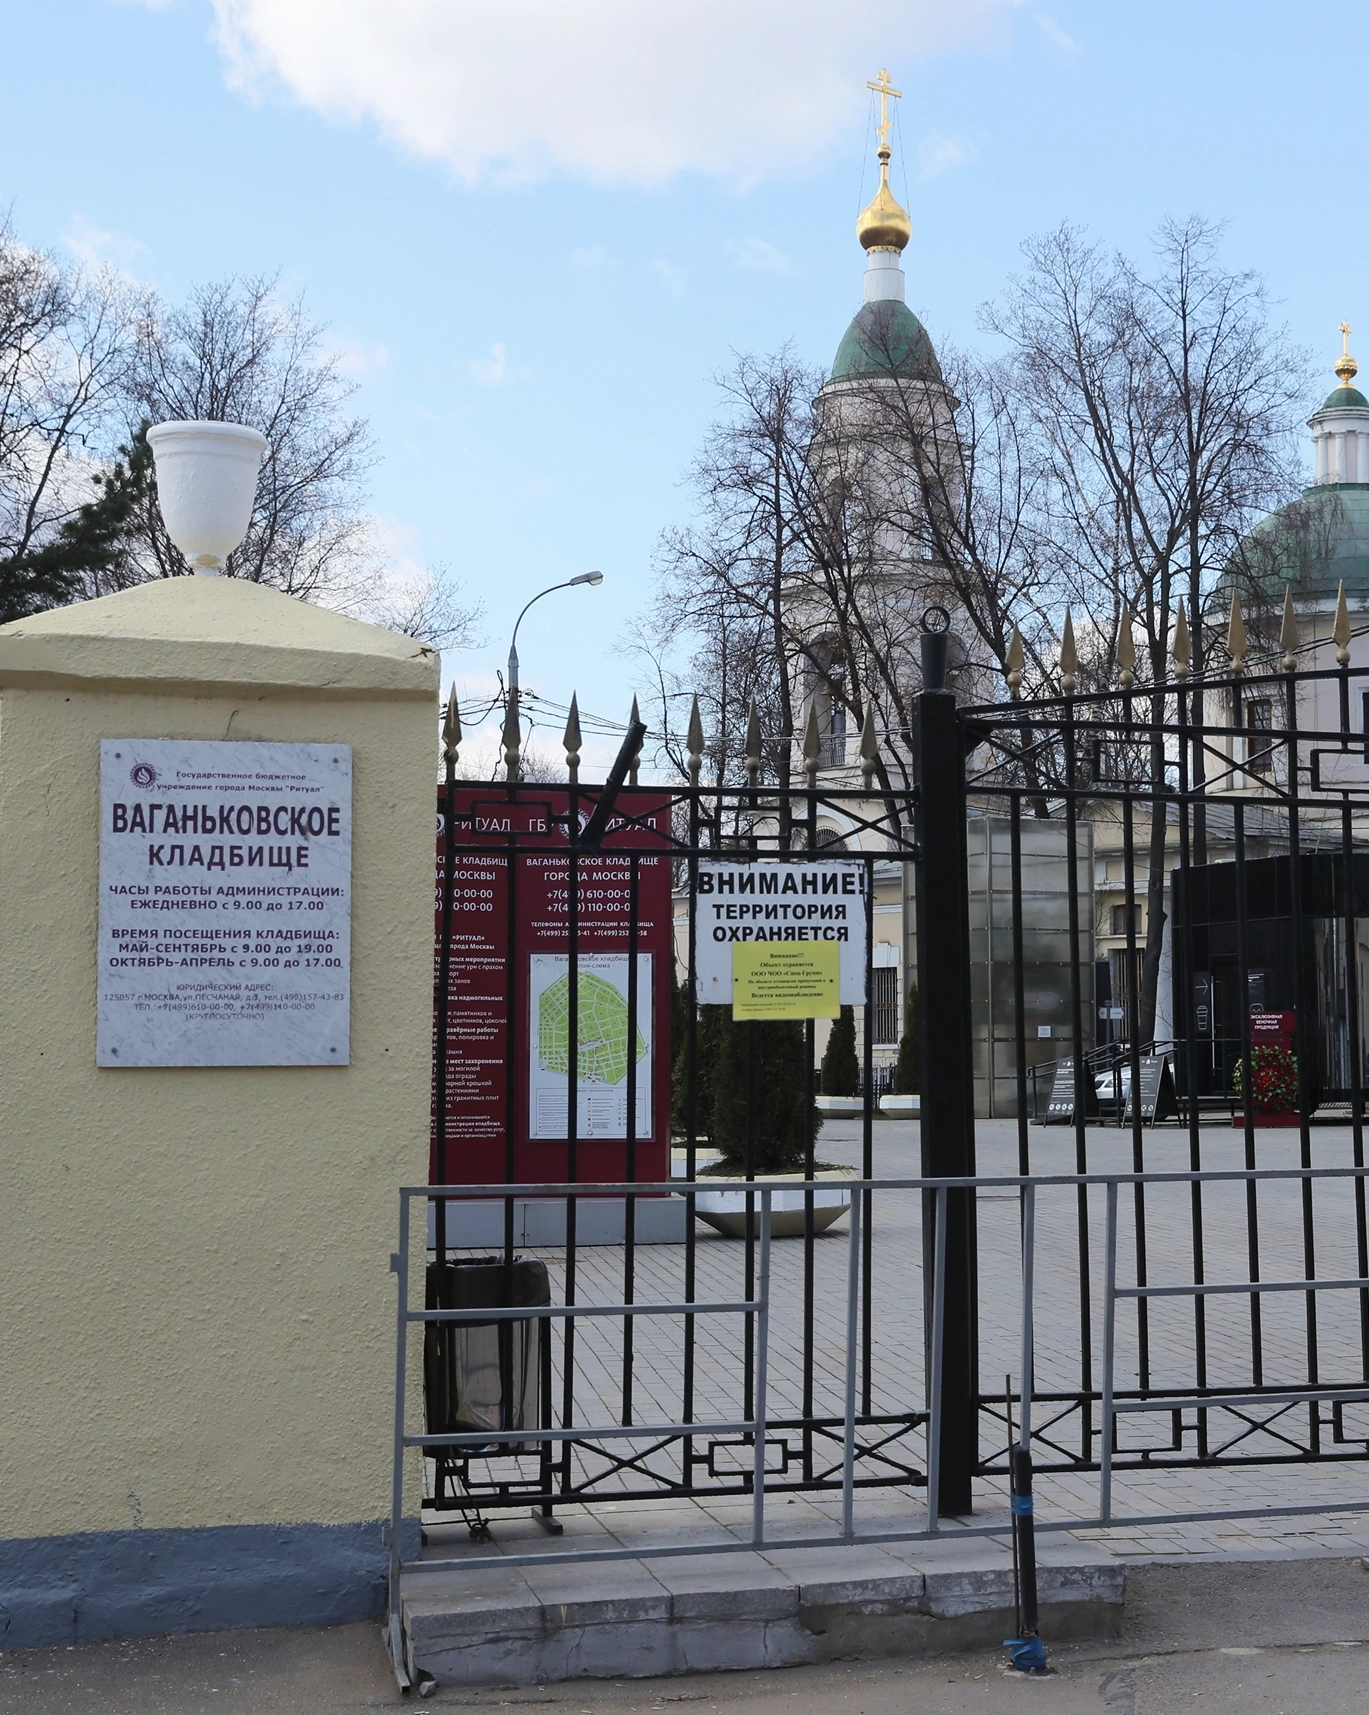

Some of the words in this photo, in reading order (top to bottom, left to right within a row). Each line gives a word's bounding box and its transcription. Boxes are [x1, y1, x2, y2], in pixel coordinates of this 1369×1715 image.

[176, 771, 253, 779] Государственное
[285, 785, 325, 793] "Ритуал"
[112, 803, 341, 837] ВАГАНЬКОВСКОЕ
[149, 844, 309, 871] КЛАДБИЩЕ
[462, 857, 508, 867] КЛАДБИЩ
[606, 857, 659, 866] КЛАДИЩЕ
[698, 872, 864, 895] ВНИМАНИЕ!
[109, 886, 149, 895] ЧАСЫ
[154, 886, 211, 895] РАБОТЫ
[216, 886, 344, 898] АДМИНИСТРАЦИИ:
[587, 890, 630, 898] 610-00-0
[130, 900, 217, 911] ЕЖЕДНЕВНО
[222, 902, 229, 910] с
[233, 900, 262, 910] 9.00
[266, 903, 283, 912] до
[287, 901, 324, 911] 17.00
[588, 903, 630, 912] 110-00-0
[712, 904, 847, 919] ТЕРРИТОРИЯ
[111, 929, 158, 939] ВРЕМЯ
[163, 929, 251, 940] ПОСЕЩЕНИЯ
[256, 930, 340, 941] КЛАДБИЩА:
[712, 926, 848, 942] ОХРАНЯЕТСЯ
[118, 941, 227, 953] МАЙ-СЕНТЯБРЬ
[242, 944, 271, 953] 9.00
[275, 946, 292, 955] до
[296, 944, 333, 953] 19.00
[109, 958, 235, 967] ОКТЯБРЬ-АПРЕЛЬ
[251, 958, 280, 967] 9.00
[283, 960, 300, 969] до
[305, 958, 342, 968] 17.00
